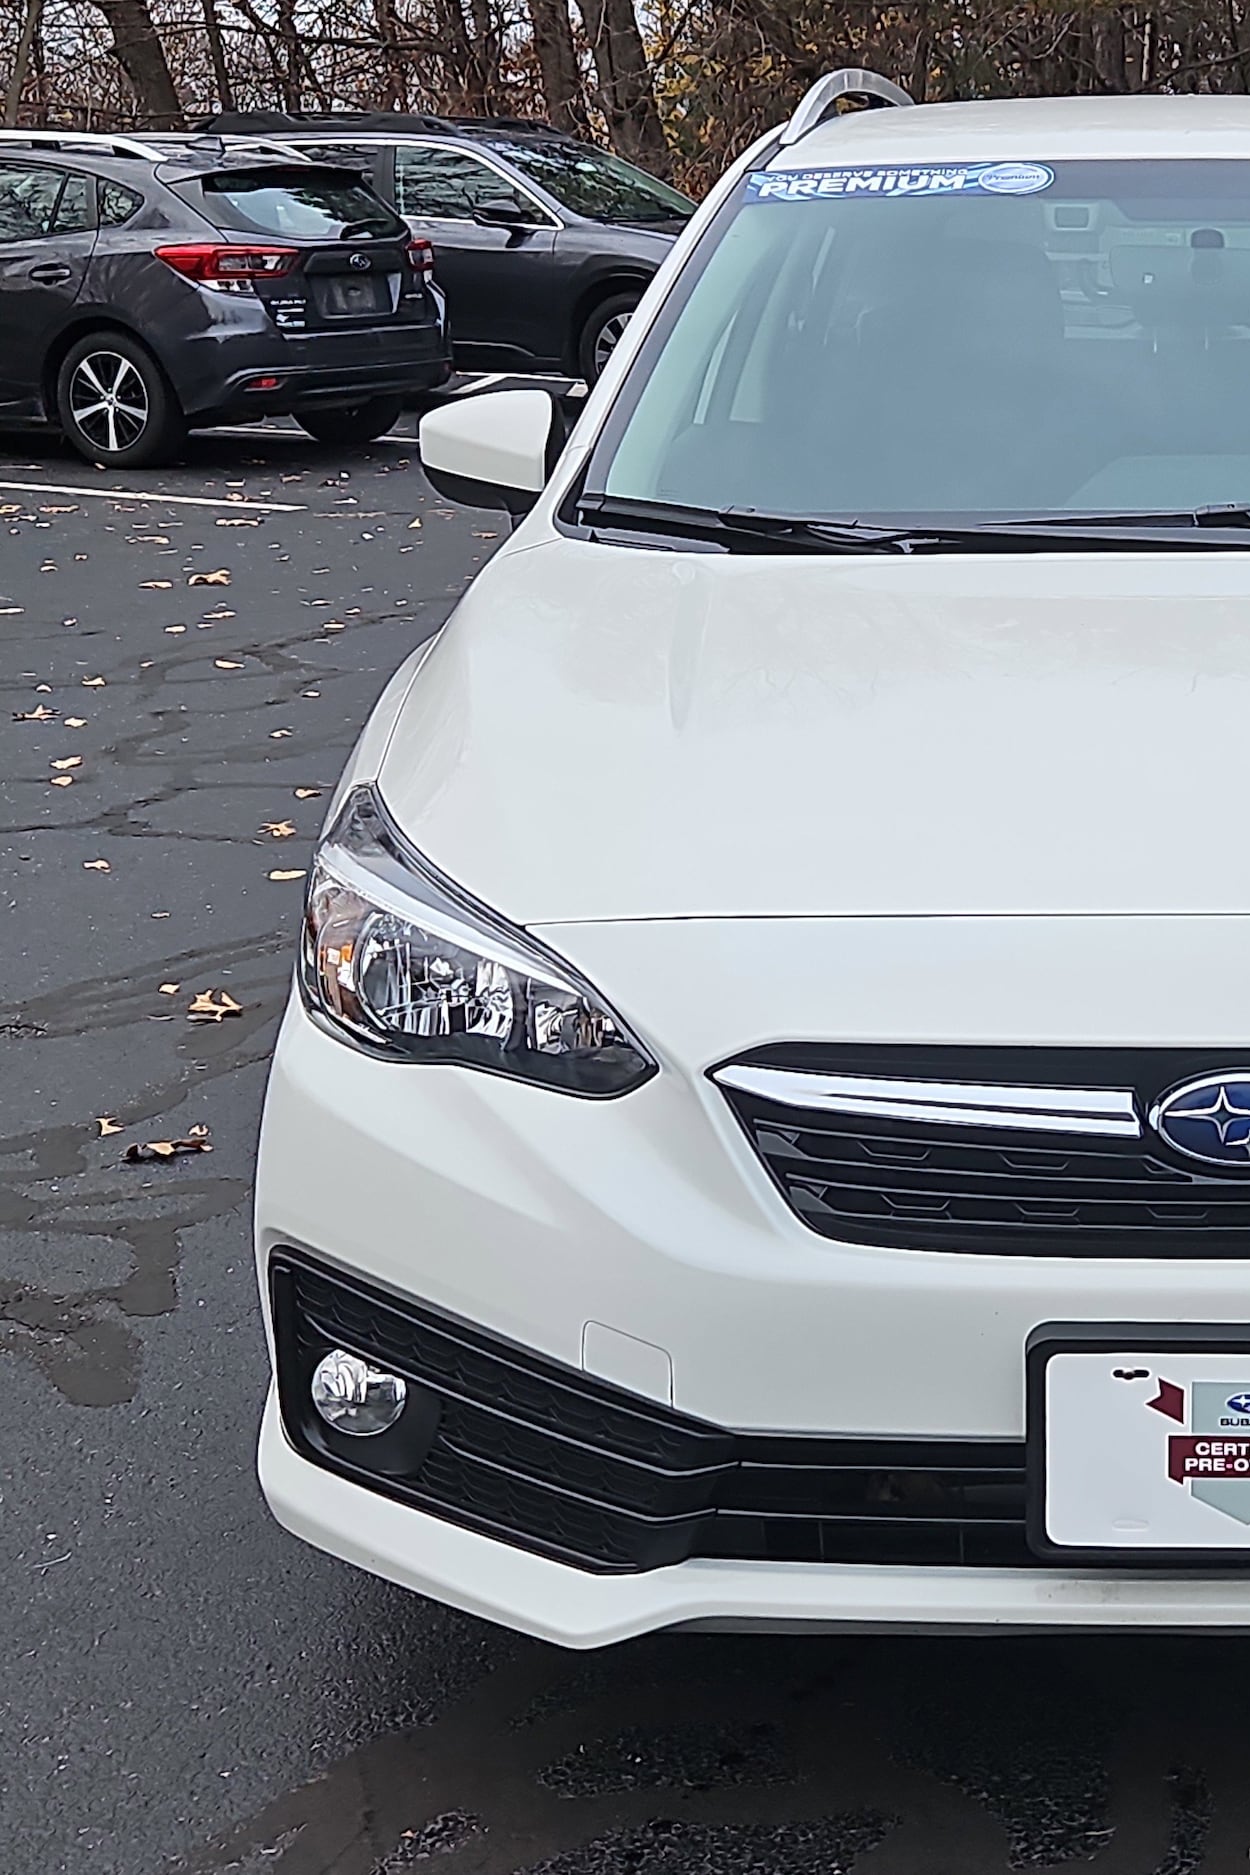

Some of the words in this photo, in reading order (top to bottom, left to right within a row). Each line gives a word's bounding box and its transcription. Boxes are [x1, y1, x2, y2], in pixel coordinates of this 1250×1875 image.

[767, 174, 799, 182] YOU
[802, 170, 874, 180] DESERVE
[877, 168, 969, 177] SOMETHING
[758, 175, 966, 197] PREMIUM
